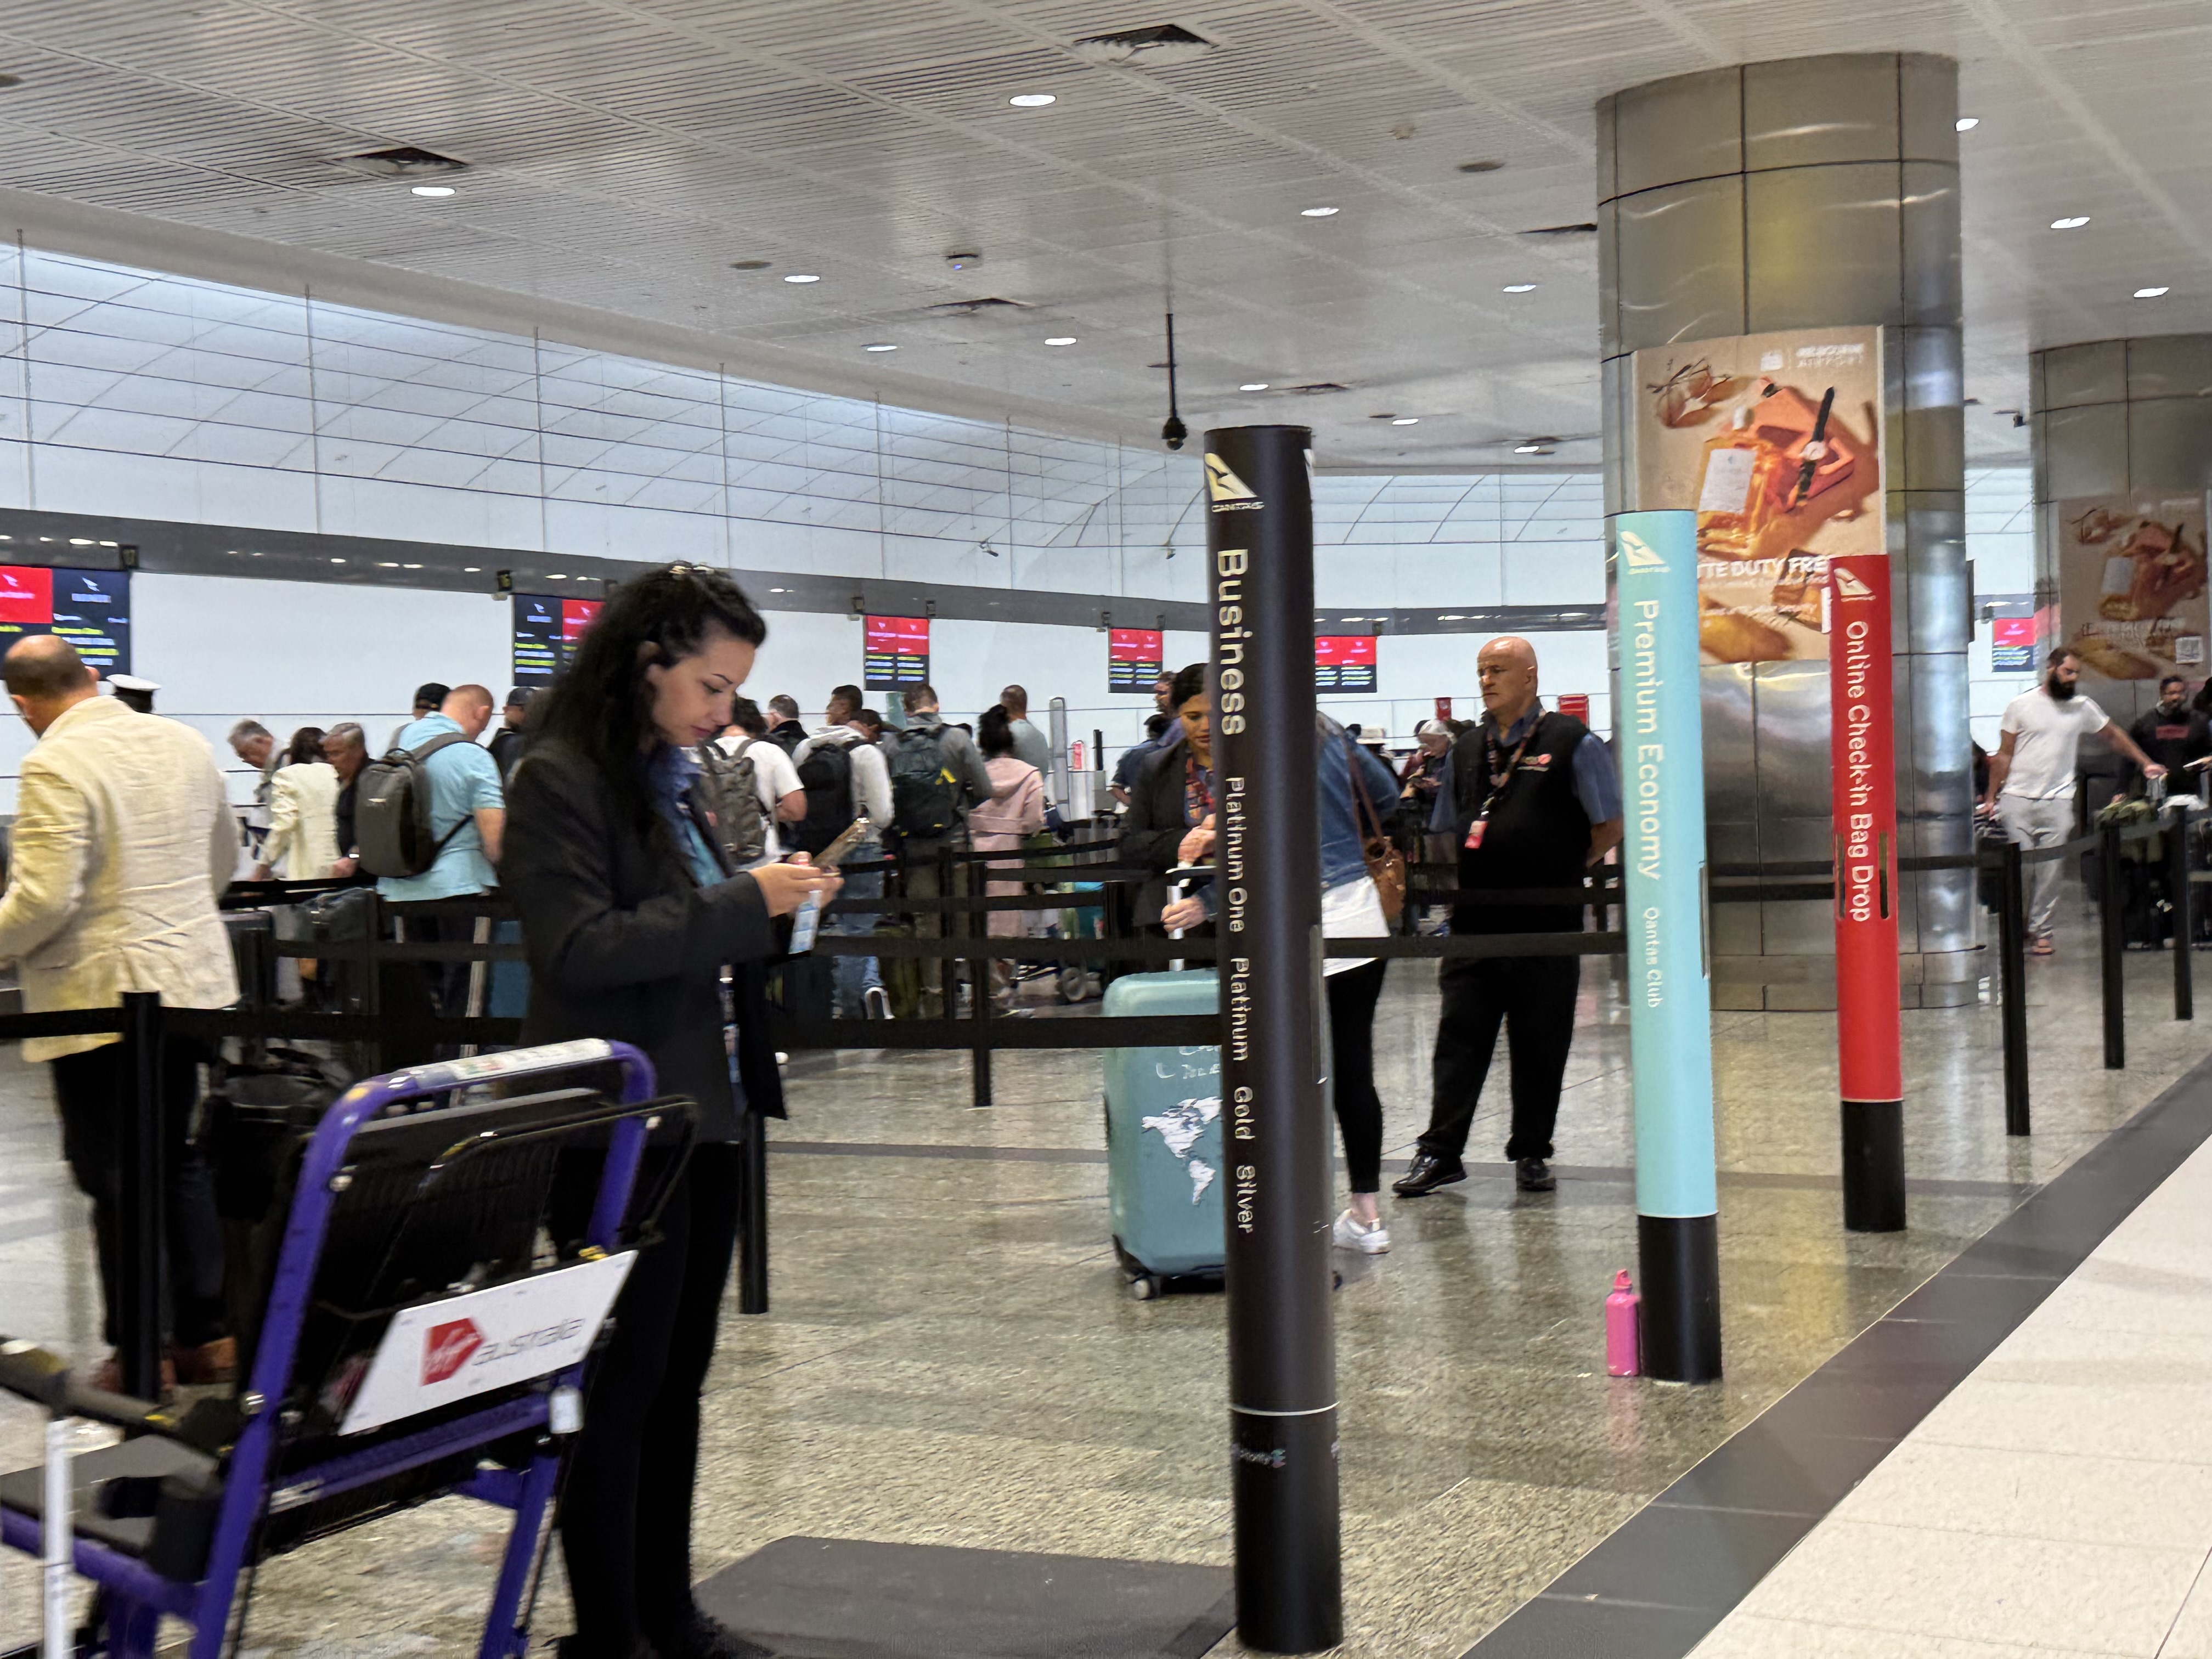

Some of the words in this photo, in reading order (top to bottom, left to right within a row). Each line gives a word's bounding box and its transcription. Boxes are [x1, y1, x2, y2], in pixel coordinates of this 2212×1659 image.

[1731, 557, 1787, 577] DUTY
[1217, 549, 1253, 735] Business
[1634, 600, 1664, 733] Premium
[1847, 621, 1871, 698] Online
[1848, 704, 1873, 806] Check-in
[1226, 777, 1247, 881] Platinum
[1638, 744, 1664, 881] Economy
[1847, 813, 1873, 857] Bag
[1228, 887, 1248, 932] One
[1849, 865, 1874, 922] Drop
[1643, 906, 1660, 965] Qantas
[1231, 957, 1251, 1061] Platinum
[1647, 969, 1663, 1008] Club
[1234, 1086, 1255, 1139] Gold
[1237, 1165, 1257, 1233] Silver
